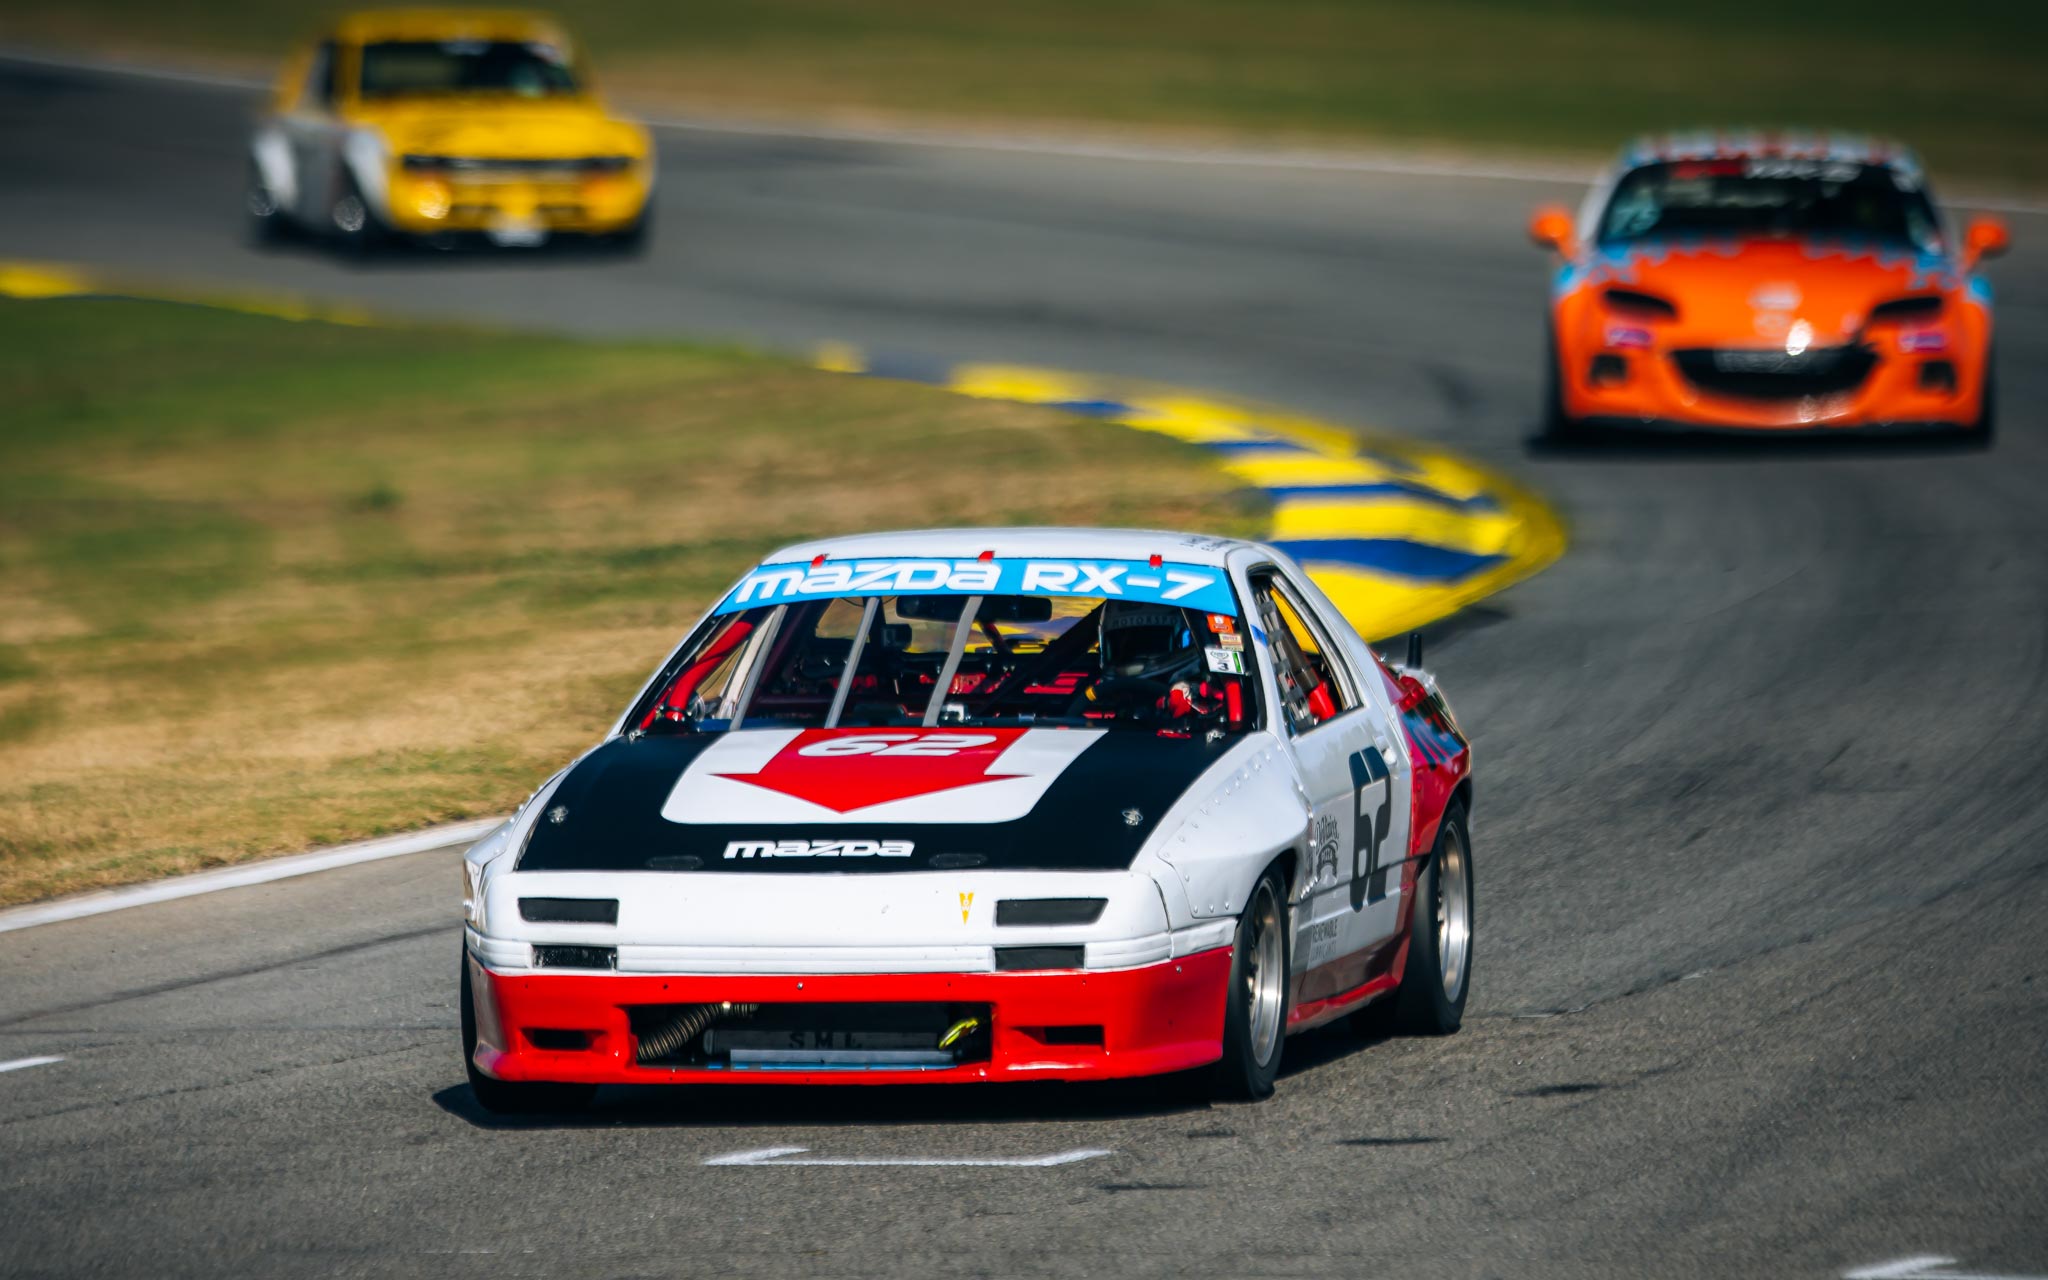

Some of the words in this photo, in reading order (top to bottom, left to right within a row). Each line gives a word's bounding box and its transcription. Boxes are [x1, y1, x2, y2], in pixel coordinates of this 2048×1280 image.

[1021, 565, 1215, 600] RX-7
[1217, 662, 1229, 672] 3
[798, 734, 996, 757] 62
[1348, 746, 1392, 913] 62
